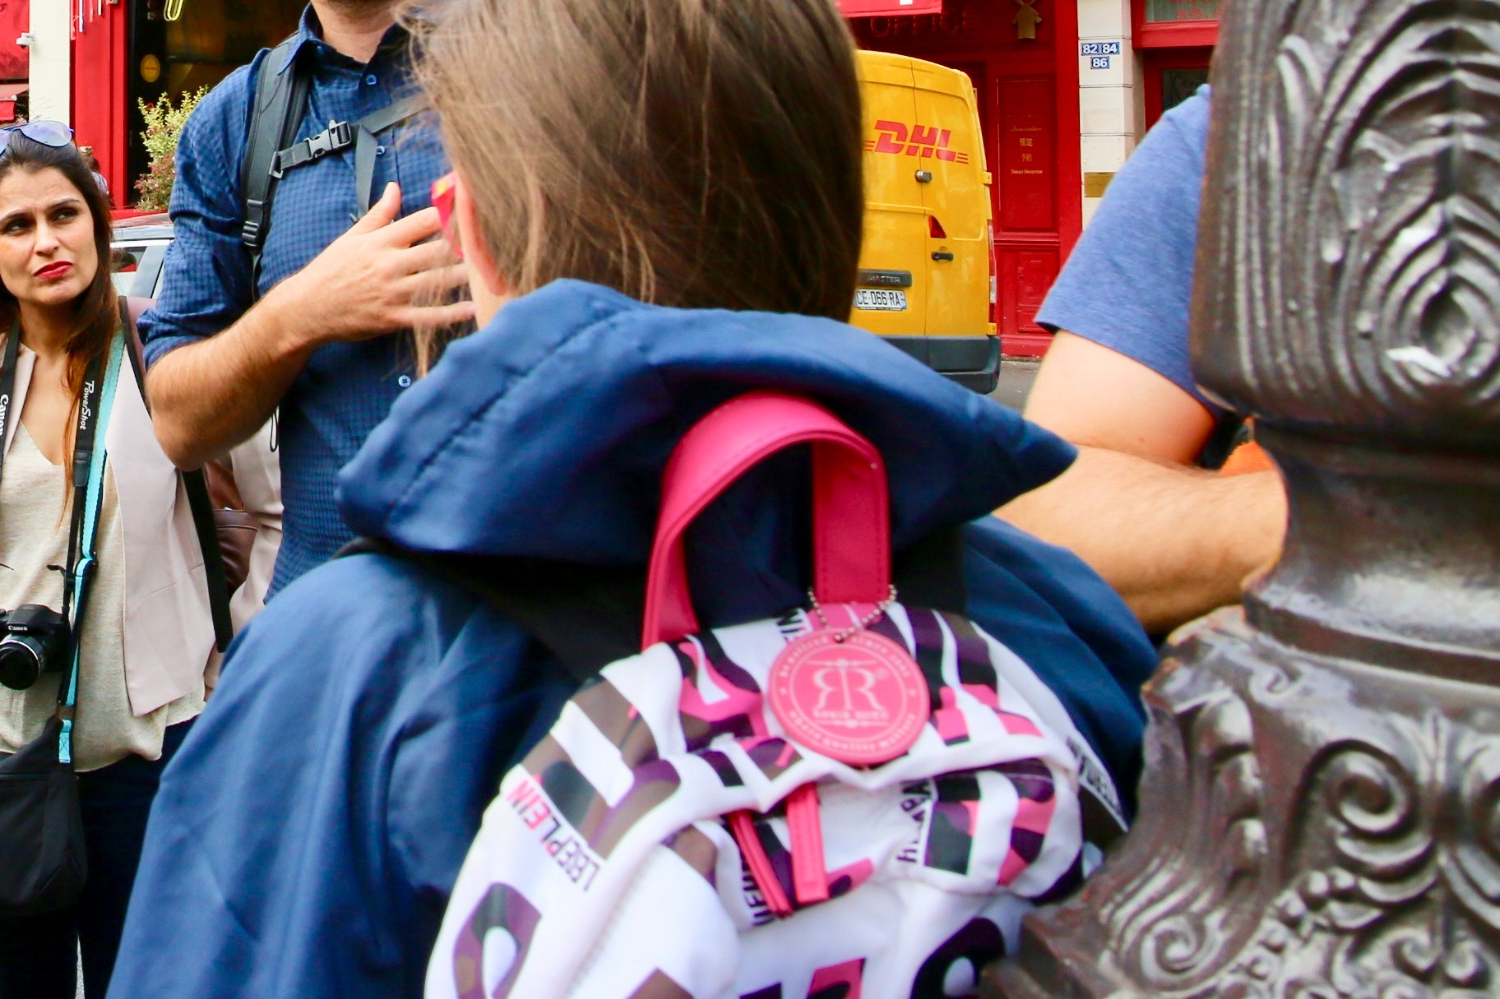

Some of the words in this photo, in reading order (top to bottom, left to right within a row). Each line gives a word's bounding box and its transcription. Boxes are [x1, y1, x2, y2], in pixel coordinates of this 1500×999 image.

[1082, 43, 1098, 54] 82
[1102, 42, 1117, 54] 84
[1092, 57, 1108, 68] 86
[874, 120, 956, 162] DHL
[866, 274, 901, 284] MASTER
[79, 380, 95, 431] PowerShot
